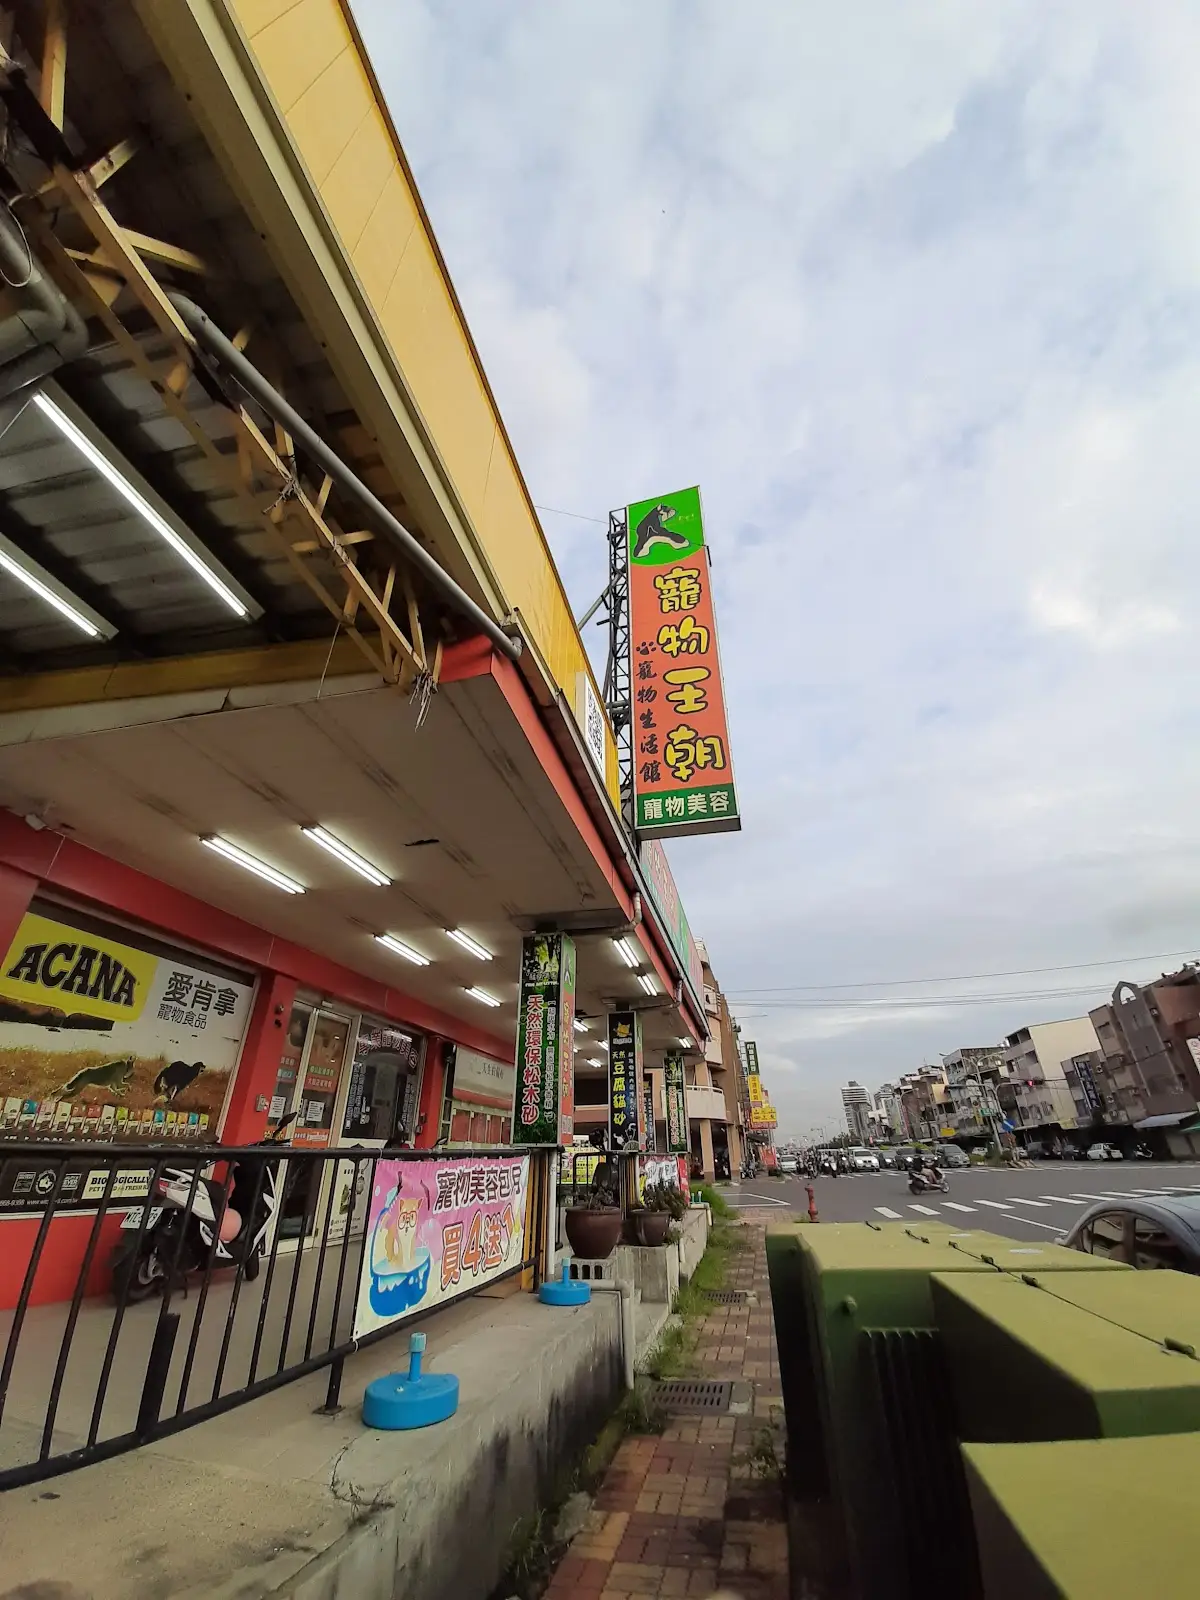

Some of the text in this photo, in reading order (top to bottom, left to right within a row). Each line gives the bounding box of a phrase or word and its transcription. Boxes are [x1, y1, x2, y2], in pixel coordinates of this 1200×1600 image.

[654, 566, 727, 782] 寵物王朝
[636, 660, 661, 784] 寵物生活館
[643, 790, 730, 821] 寵物美容
[6, 943, 138, 1008] ACANA
[162, 970, 240, 1017] 愛肯拿
[156, 1004, 208, 1030] 寵物食品
[521, 994, 545, 1125] 天然環保松木砂
[613, 1061, 627, 1126] 豆腐貓砂
[91, 1177, 149, 1185] BIOOGICALLY
